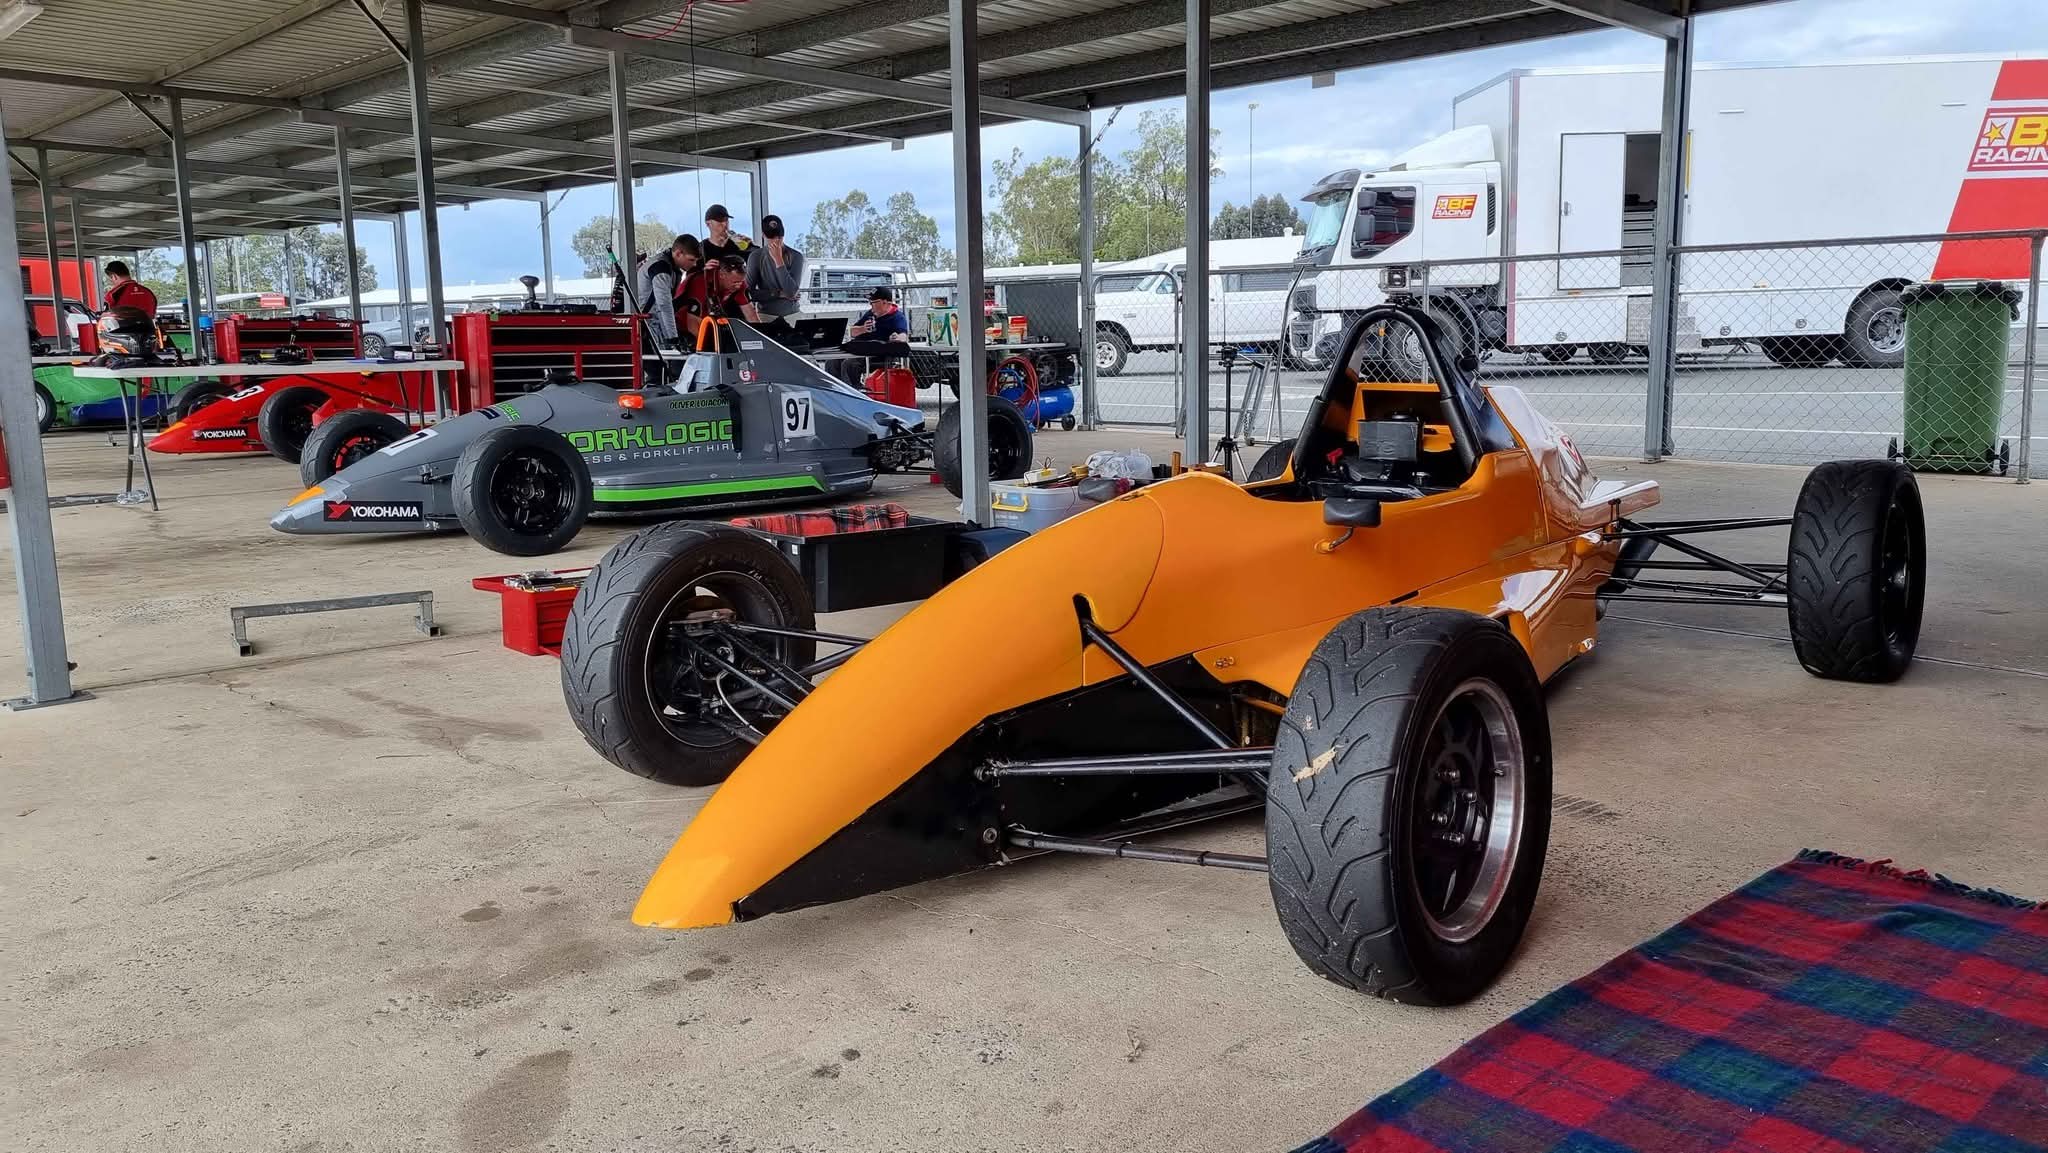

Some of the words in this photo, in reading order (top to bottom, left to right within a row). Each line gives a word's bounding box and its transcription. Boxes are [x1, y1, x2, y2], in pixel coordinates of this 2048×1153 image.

[2009, 115, 2048, 147] B
[1973, 146, 2048, 163] RACIN
[1448, 198, 1475, 210] BF
[1435, 209, 1472, 217] RACING
[669, 400, 695, 410] OLIVER
[696, 398, 730, 408] LOIACON
[785, 397, 811, 432] 97
[202, 429, 247, 439] YOKOHAMA
[583, 454, 612, 465] ESS
[618, 453, 627, 461] &
[633, 445, 702, 460] FORKLIFT
[350, 505, 420, 518] YOKOHAMA
